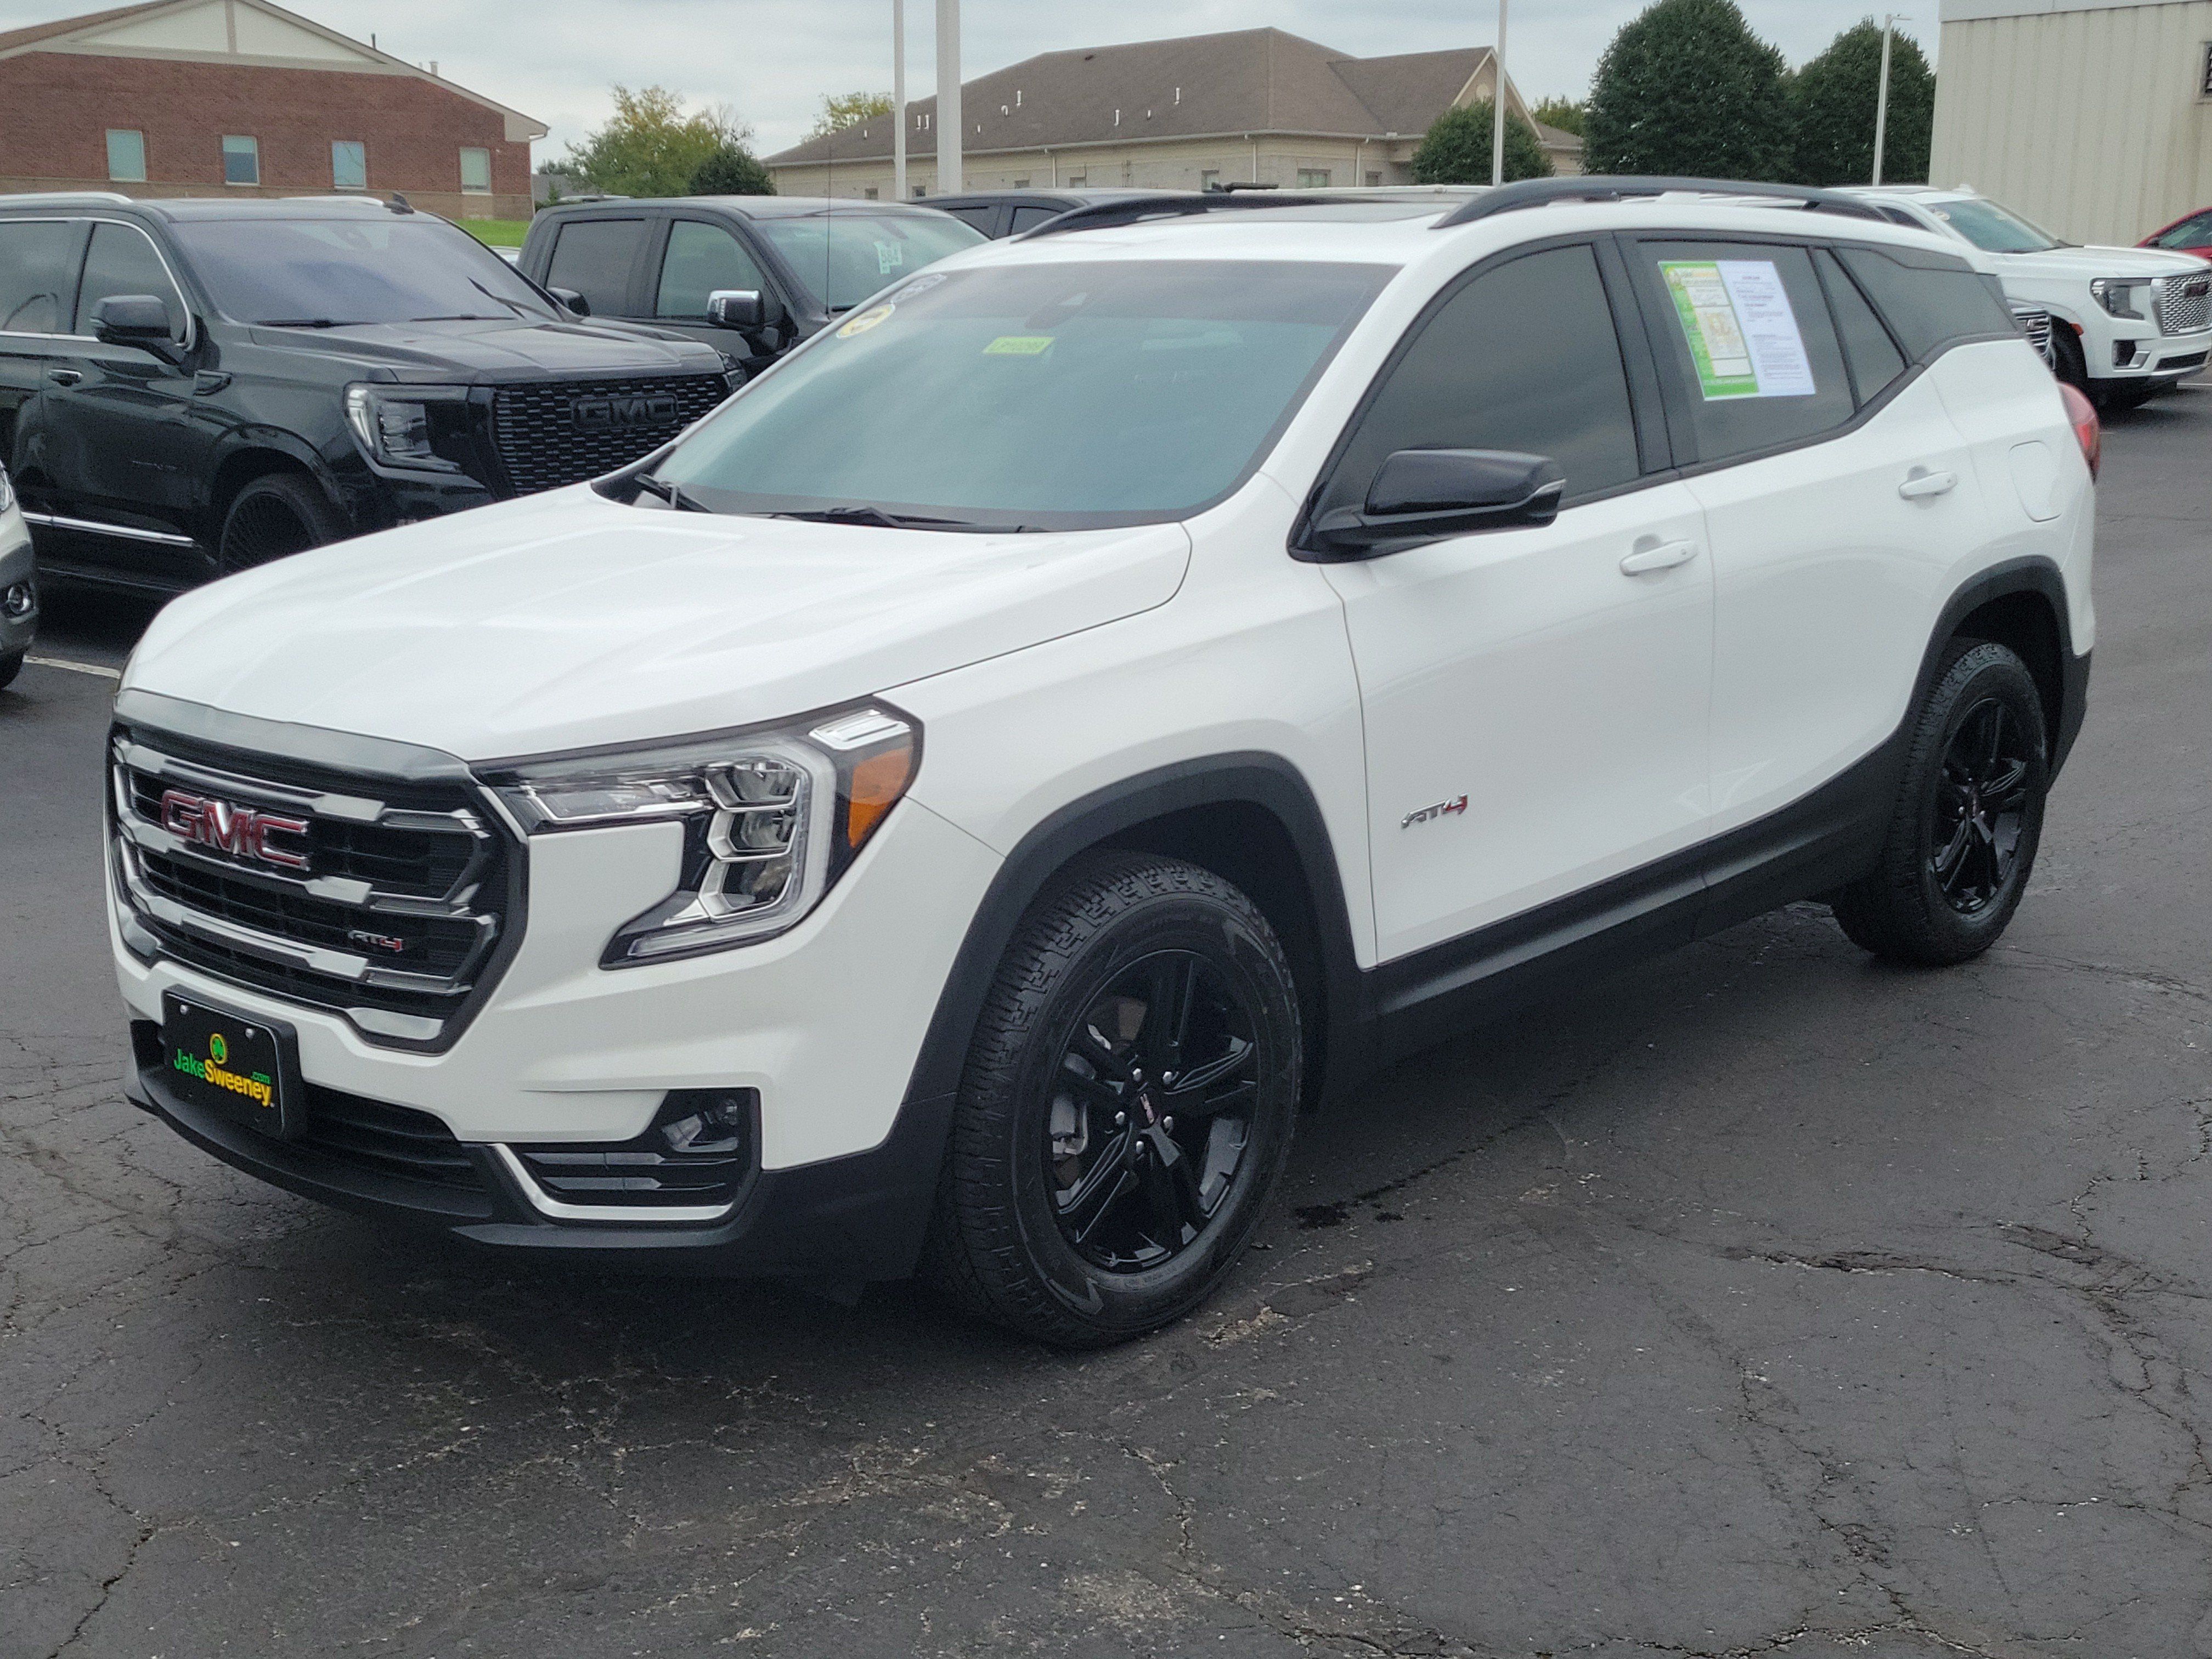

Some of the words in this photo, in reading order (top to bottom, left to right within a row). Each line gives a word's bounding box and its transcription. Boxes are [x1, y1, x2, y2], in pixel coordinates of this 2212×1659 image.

[577, 397, 678, 426] GMC
[1401, 793, 1468, 828] AT4
[161, 789, 311, 872] GMC
[347, 929, 404, 952] AT4
